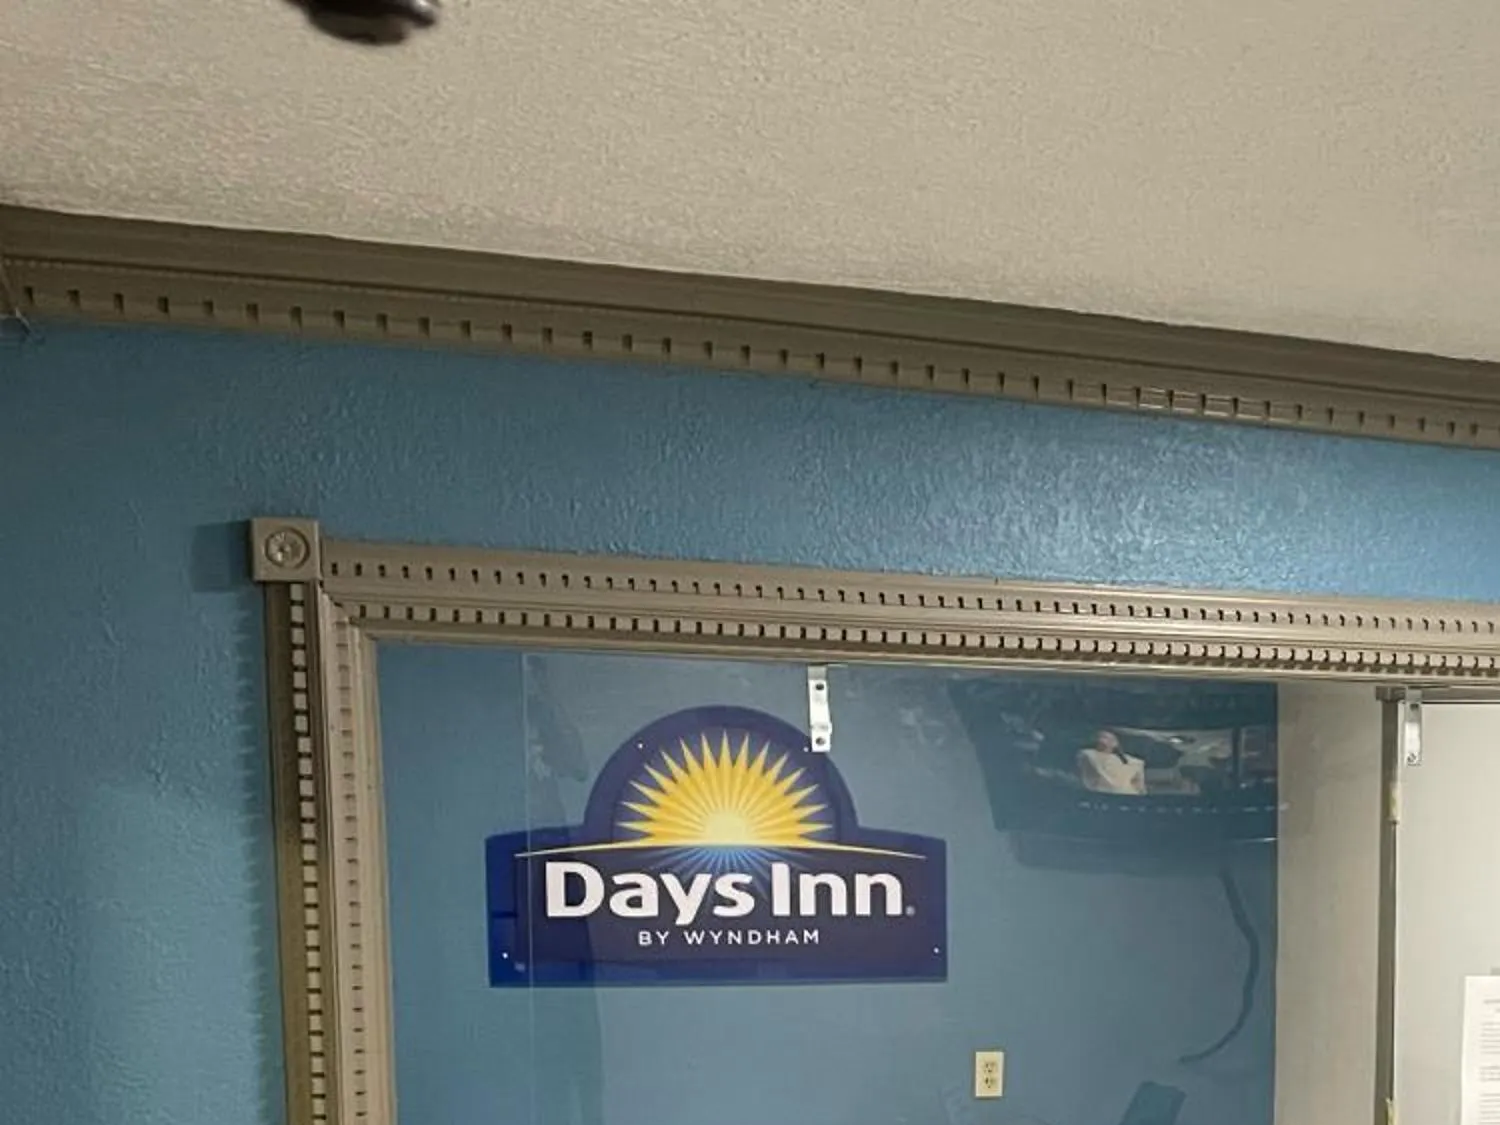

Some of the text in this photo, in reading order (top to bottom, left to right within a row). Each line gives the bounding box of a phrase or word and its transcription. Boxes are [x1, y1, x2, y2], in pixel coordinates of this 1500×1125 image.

[545, 861, 903, 926] Days Inn
[638, 929, 820, 947] BY WYNDHAM
